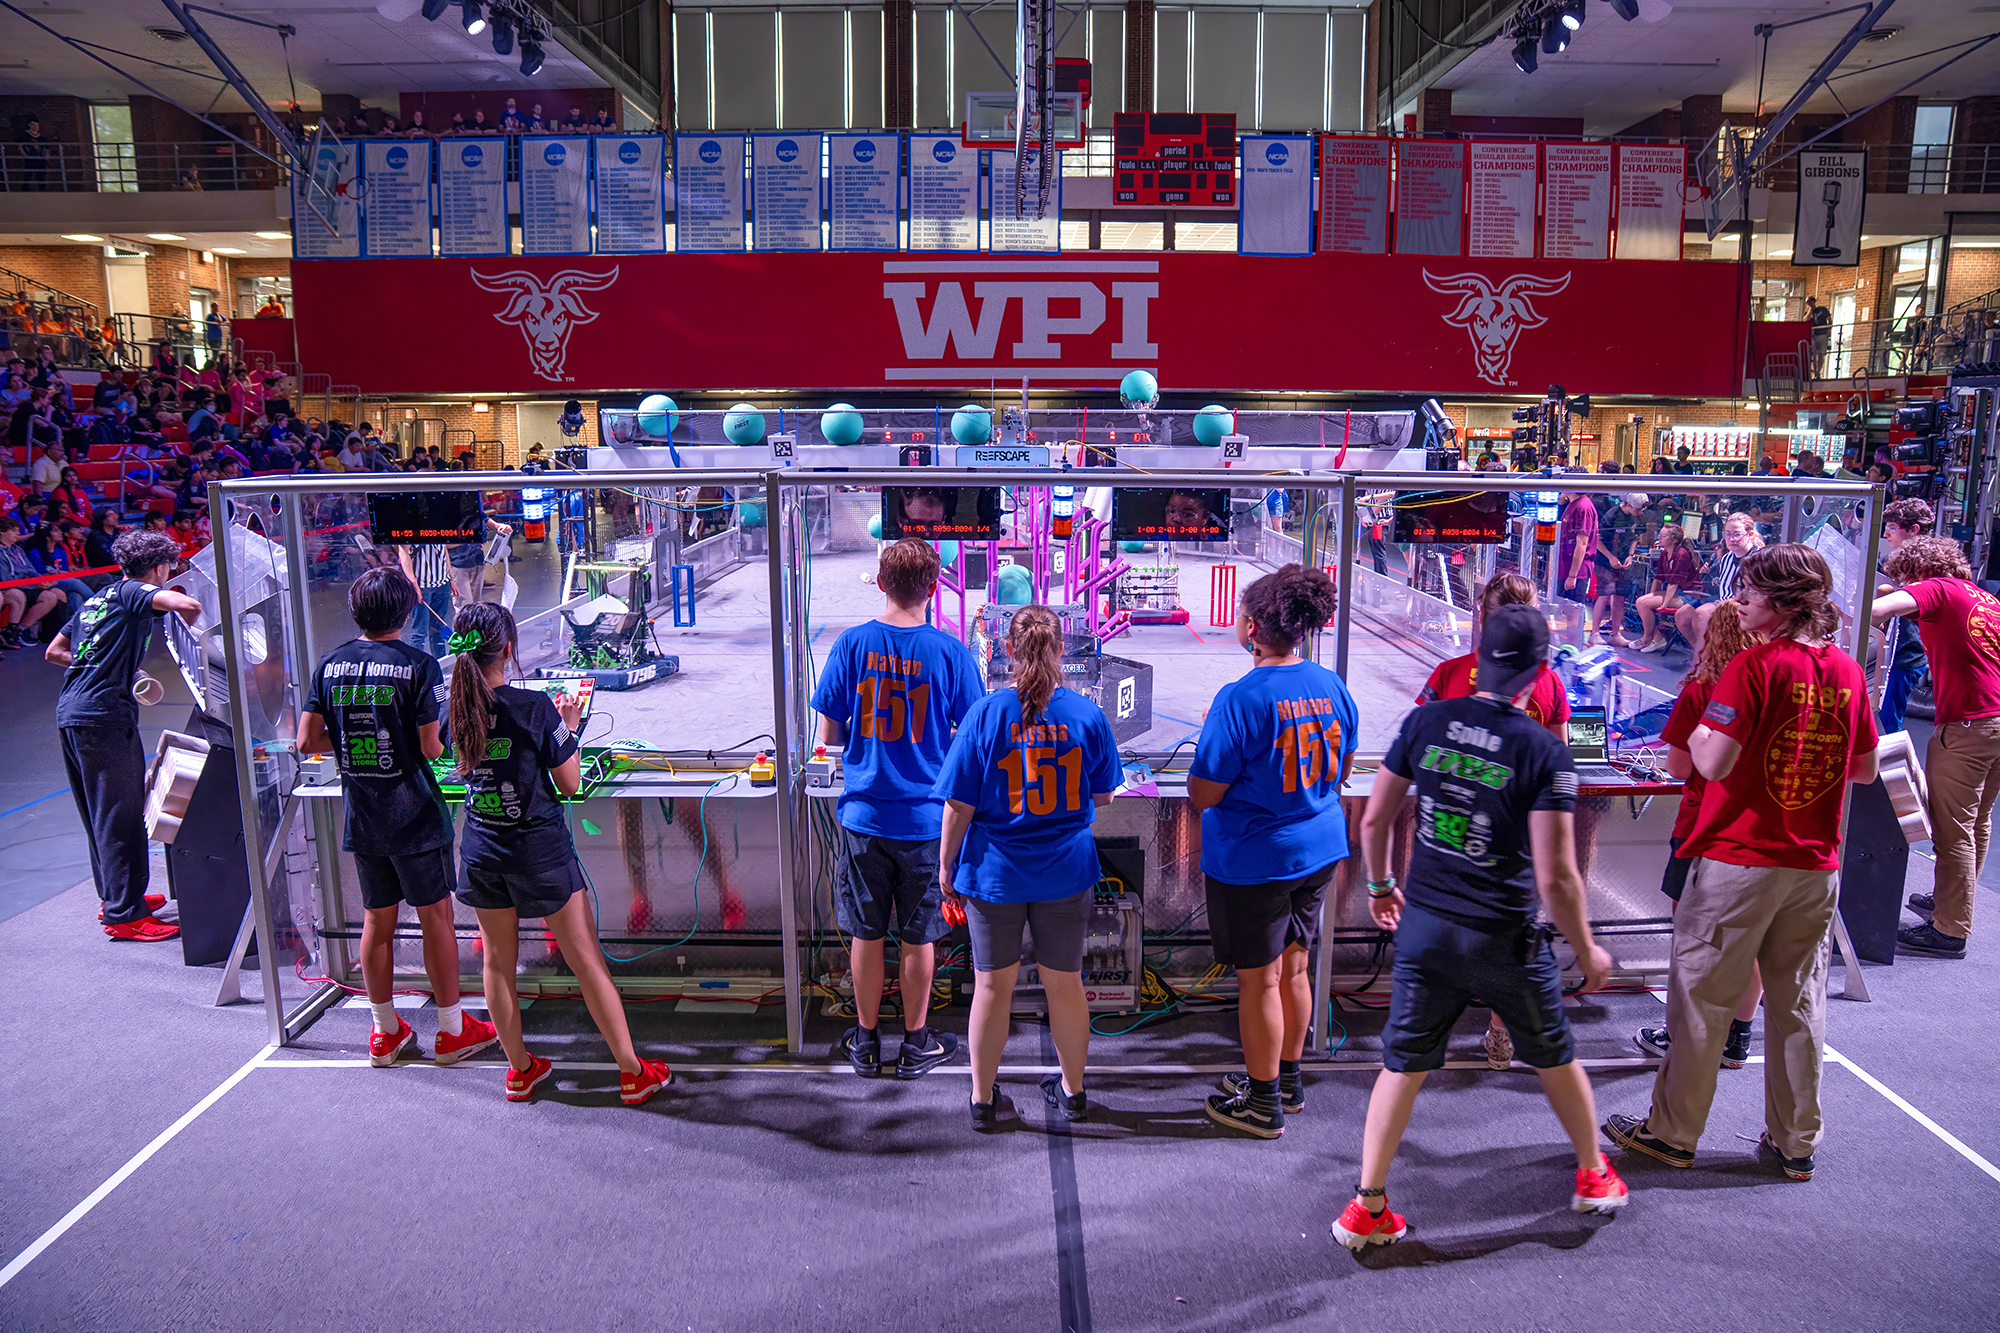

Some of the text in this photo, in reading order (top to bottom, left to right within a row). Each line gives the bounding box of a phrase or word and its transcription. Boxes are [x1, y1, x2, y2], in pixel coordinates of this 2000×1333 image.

[1164, 146, 1186, 156] period
[1119, 161, 1135, 169] fouls
[1163, 160, 1187, 170] player
[1215, 161, 1231, 170] fouls
[1325, 156, 1387, 166] CHAMPIONS
[1401, 159, 1462, 169] CHAMPIONS
[1474, 161, 1535, 170] CHAMPIONS
[1548, 162, 1609, 172] CHAMPIONS
[1819, 157, 1846, 166] BILL
[1622, 164, 1682, 173] CHAMPIONS
[1805, 168, 1860, 177] GIBBONS
[1165, 193, 1184, 201] game
[883, 282, 1159, 359] WPI
[734, 420, 749, 430] FIRST
[976, 451, 1030, 461] REEFSCAPE
[324, 661, 413, 680] Digital Nomad
[867, 652, 921, 676] Nathan
[627, 665, 657, 685] 1796
[331, 685, 396, 706] 1796
[1792, 683, 1851, 708] 5687
[856, 676, 930, 744] 151
[1277, 697, 1332, 721] Makena
[1010, 723, 1068, 745] Alyssa
[350, 738, 377, 754] 20
[1274, 719, 1341, 793] 151
[1418, 744, 1515, 790] 1796
[997, 747, 1082, 815] 151
[473, 792, 501, 808] 20
[1434, 811, 1468, 837] 20
[1089, 971, 1132, 984] FIRST
